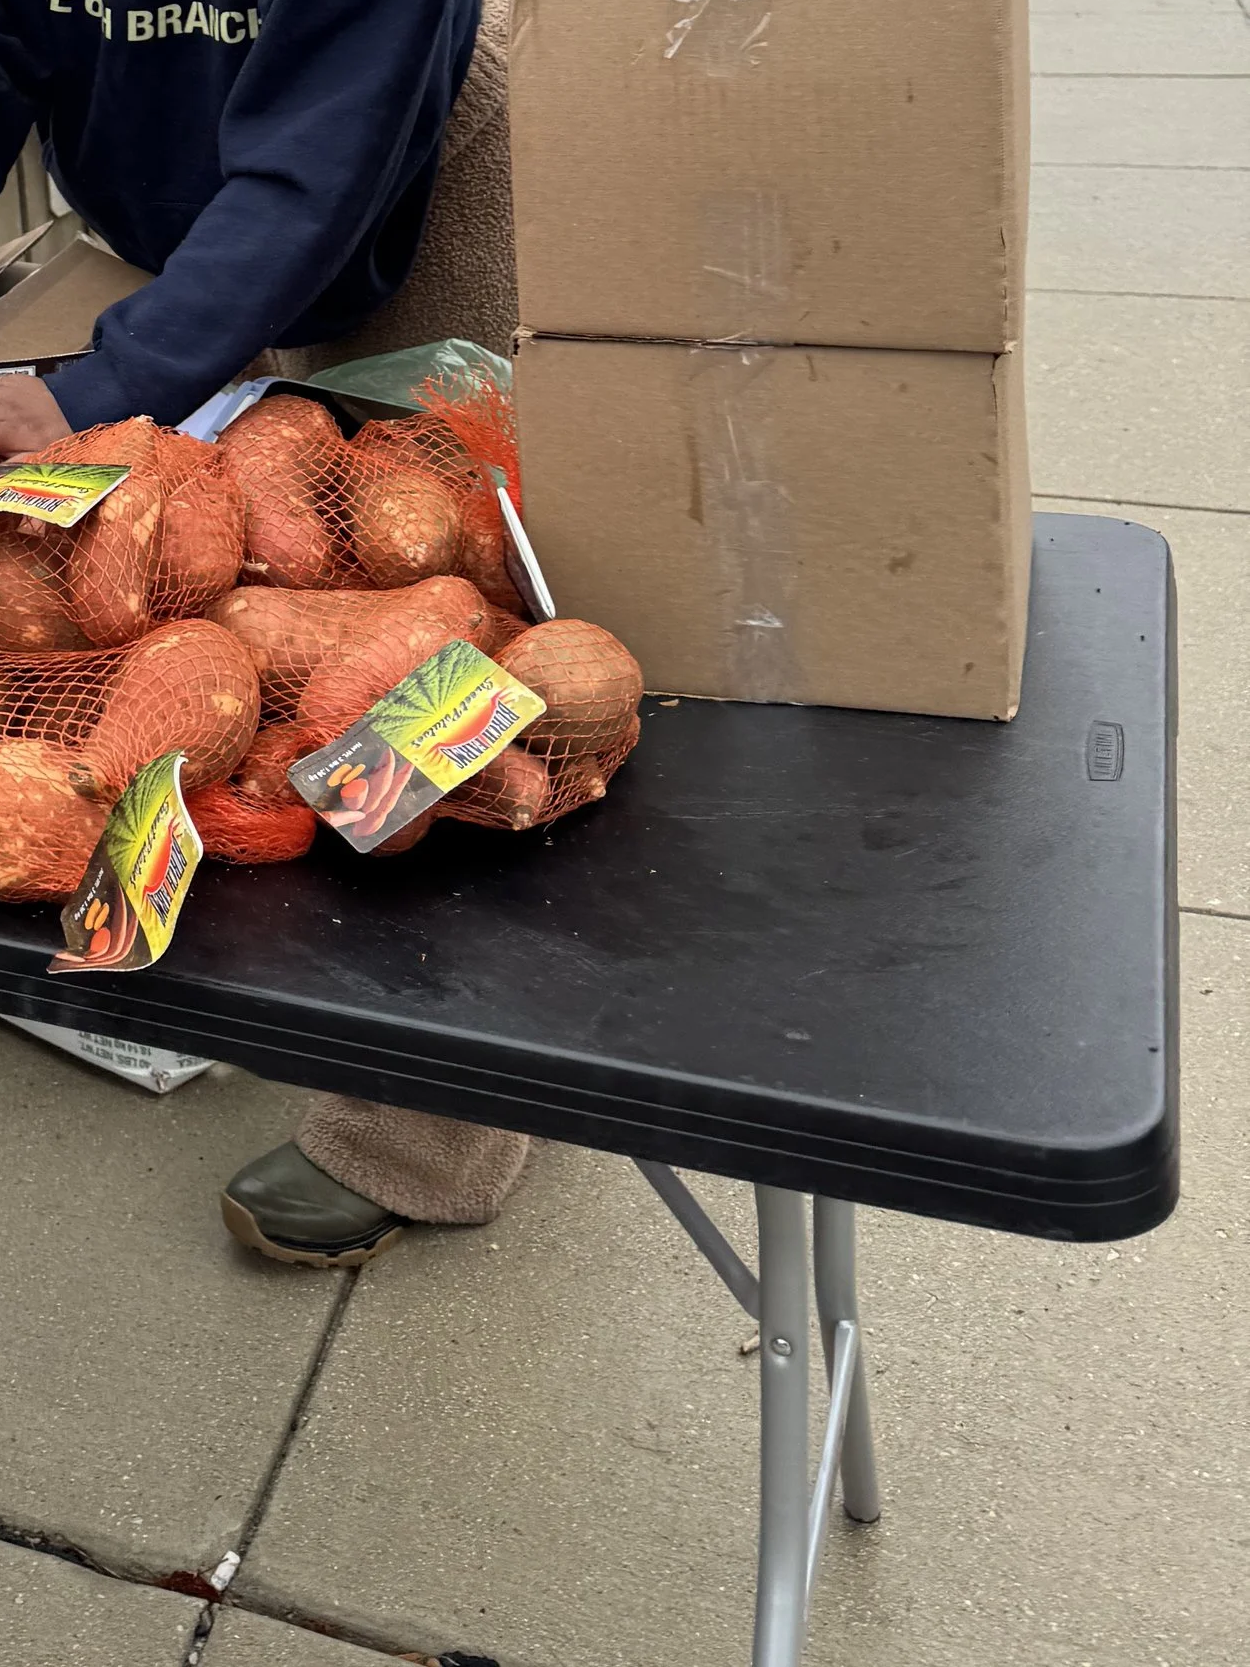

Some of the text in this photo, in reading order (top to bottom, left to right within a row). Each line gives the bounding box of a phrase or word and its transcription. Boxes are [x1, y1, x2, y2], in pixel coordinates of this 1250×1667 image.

[410, 675, 494, 749] Sweet Potatoes
[440, 699, 521, 770] BURCH FARMS
